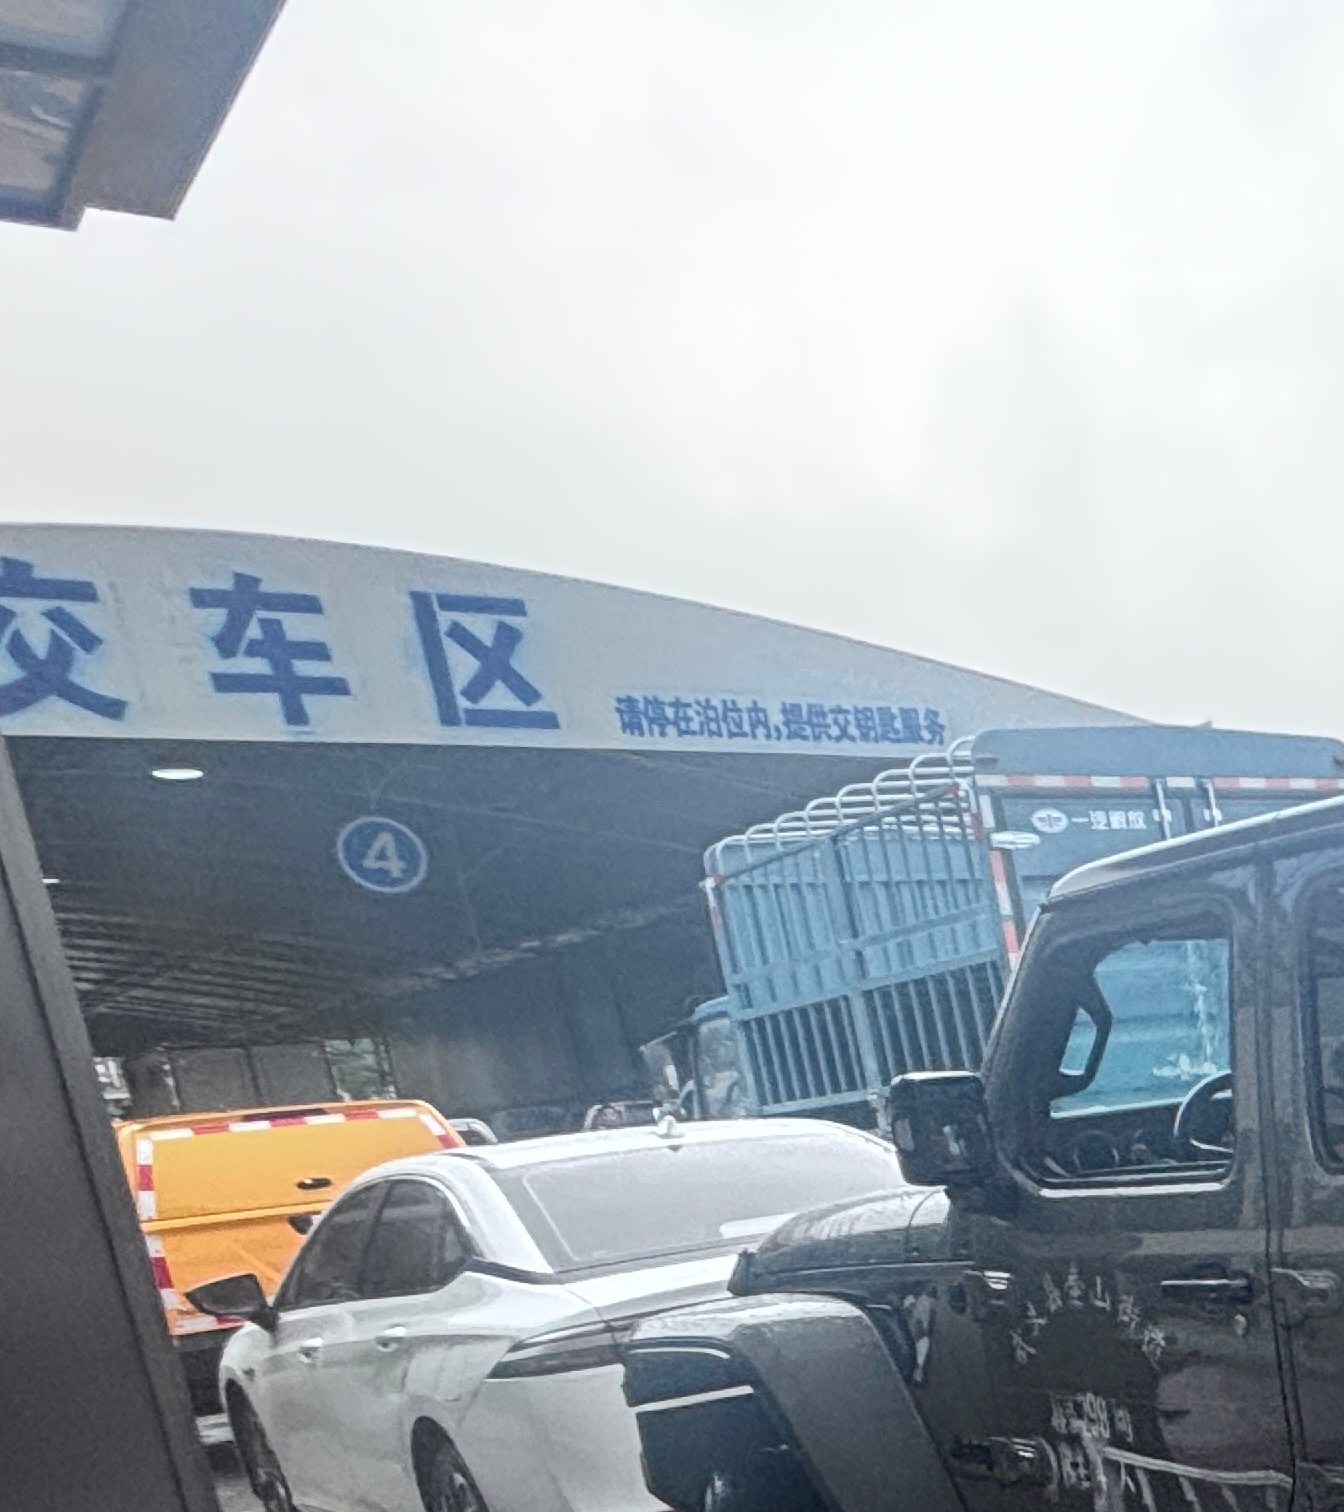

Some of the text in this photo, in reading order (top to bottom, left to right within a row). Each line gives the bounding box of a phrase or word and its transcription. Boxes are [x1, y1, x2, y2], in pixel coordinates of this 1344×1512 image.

[0, 556, 561, 730] 交车区
[363, 832, 406, 878] 4
